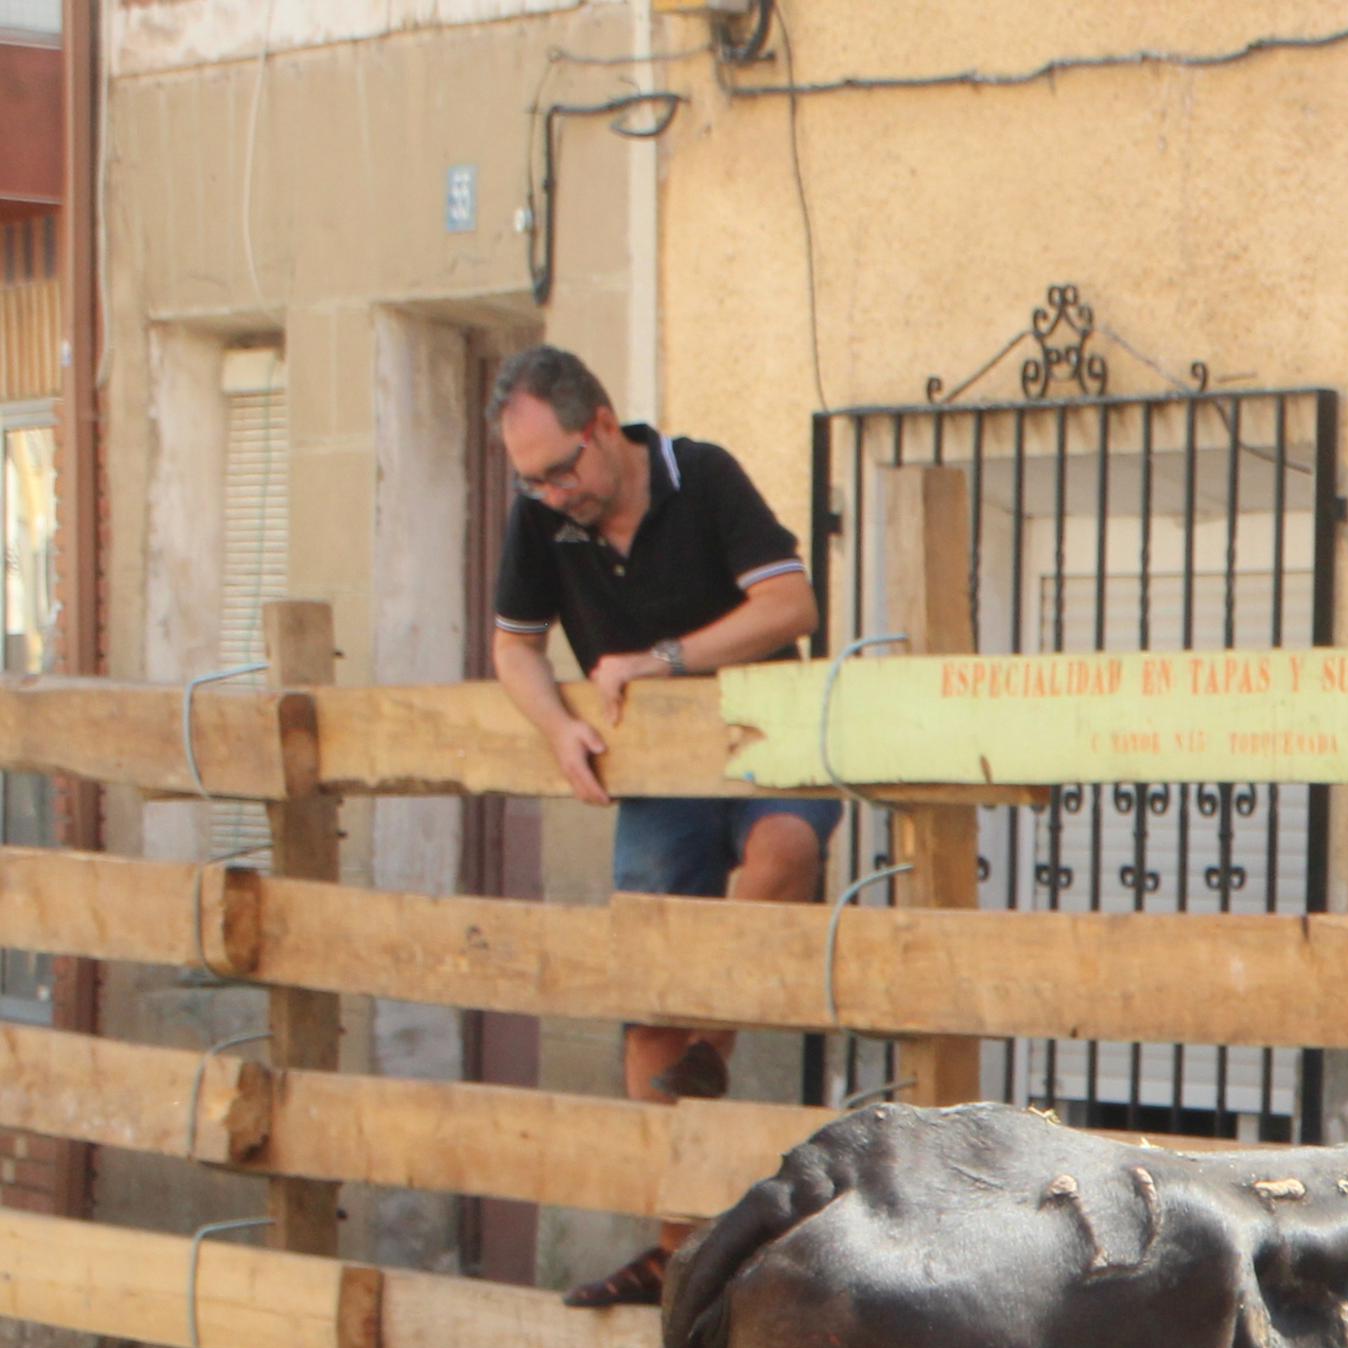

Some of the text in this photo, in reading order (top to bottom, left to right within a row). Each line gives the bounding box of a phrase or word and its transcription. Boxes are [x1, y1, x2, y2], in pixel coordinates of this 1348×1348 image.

[941, 658, 1123, 698] ESPECIALIDAD
[1141, 659, 1174, 696] EN
[1189, 656, 1272, 695] TAPAS
[1289, 655, 1305, 693] Y
